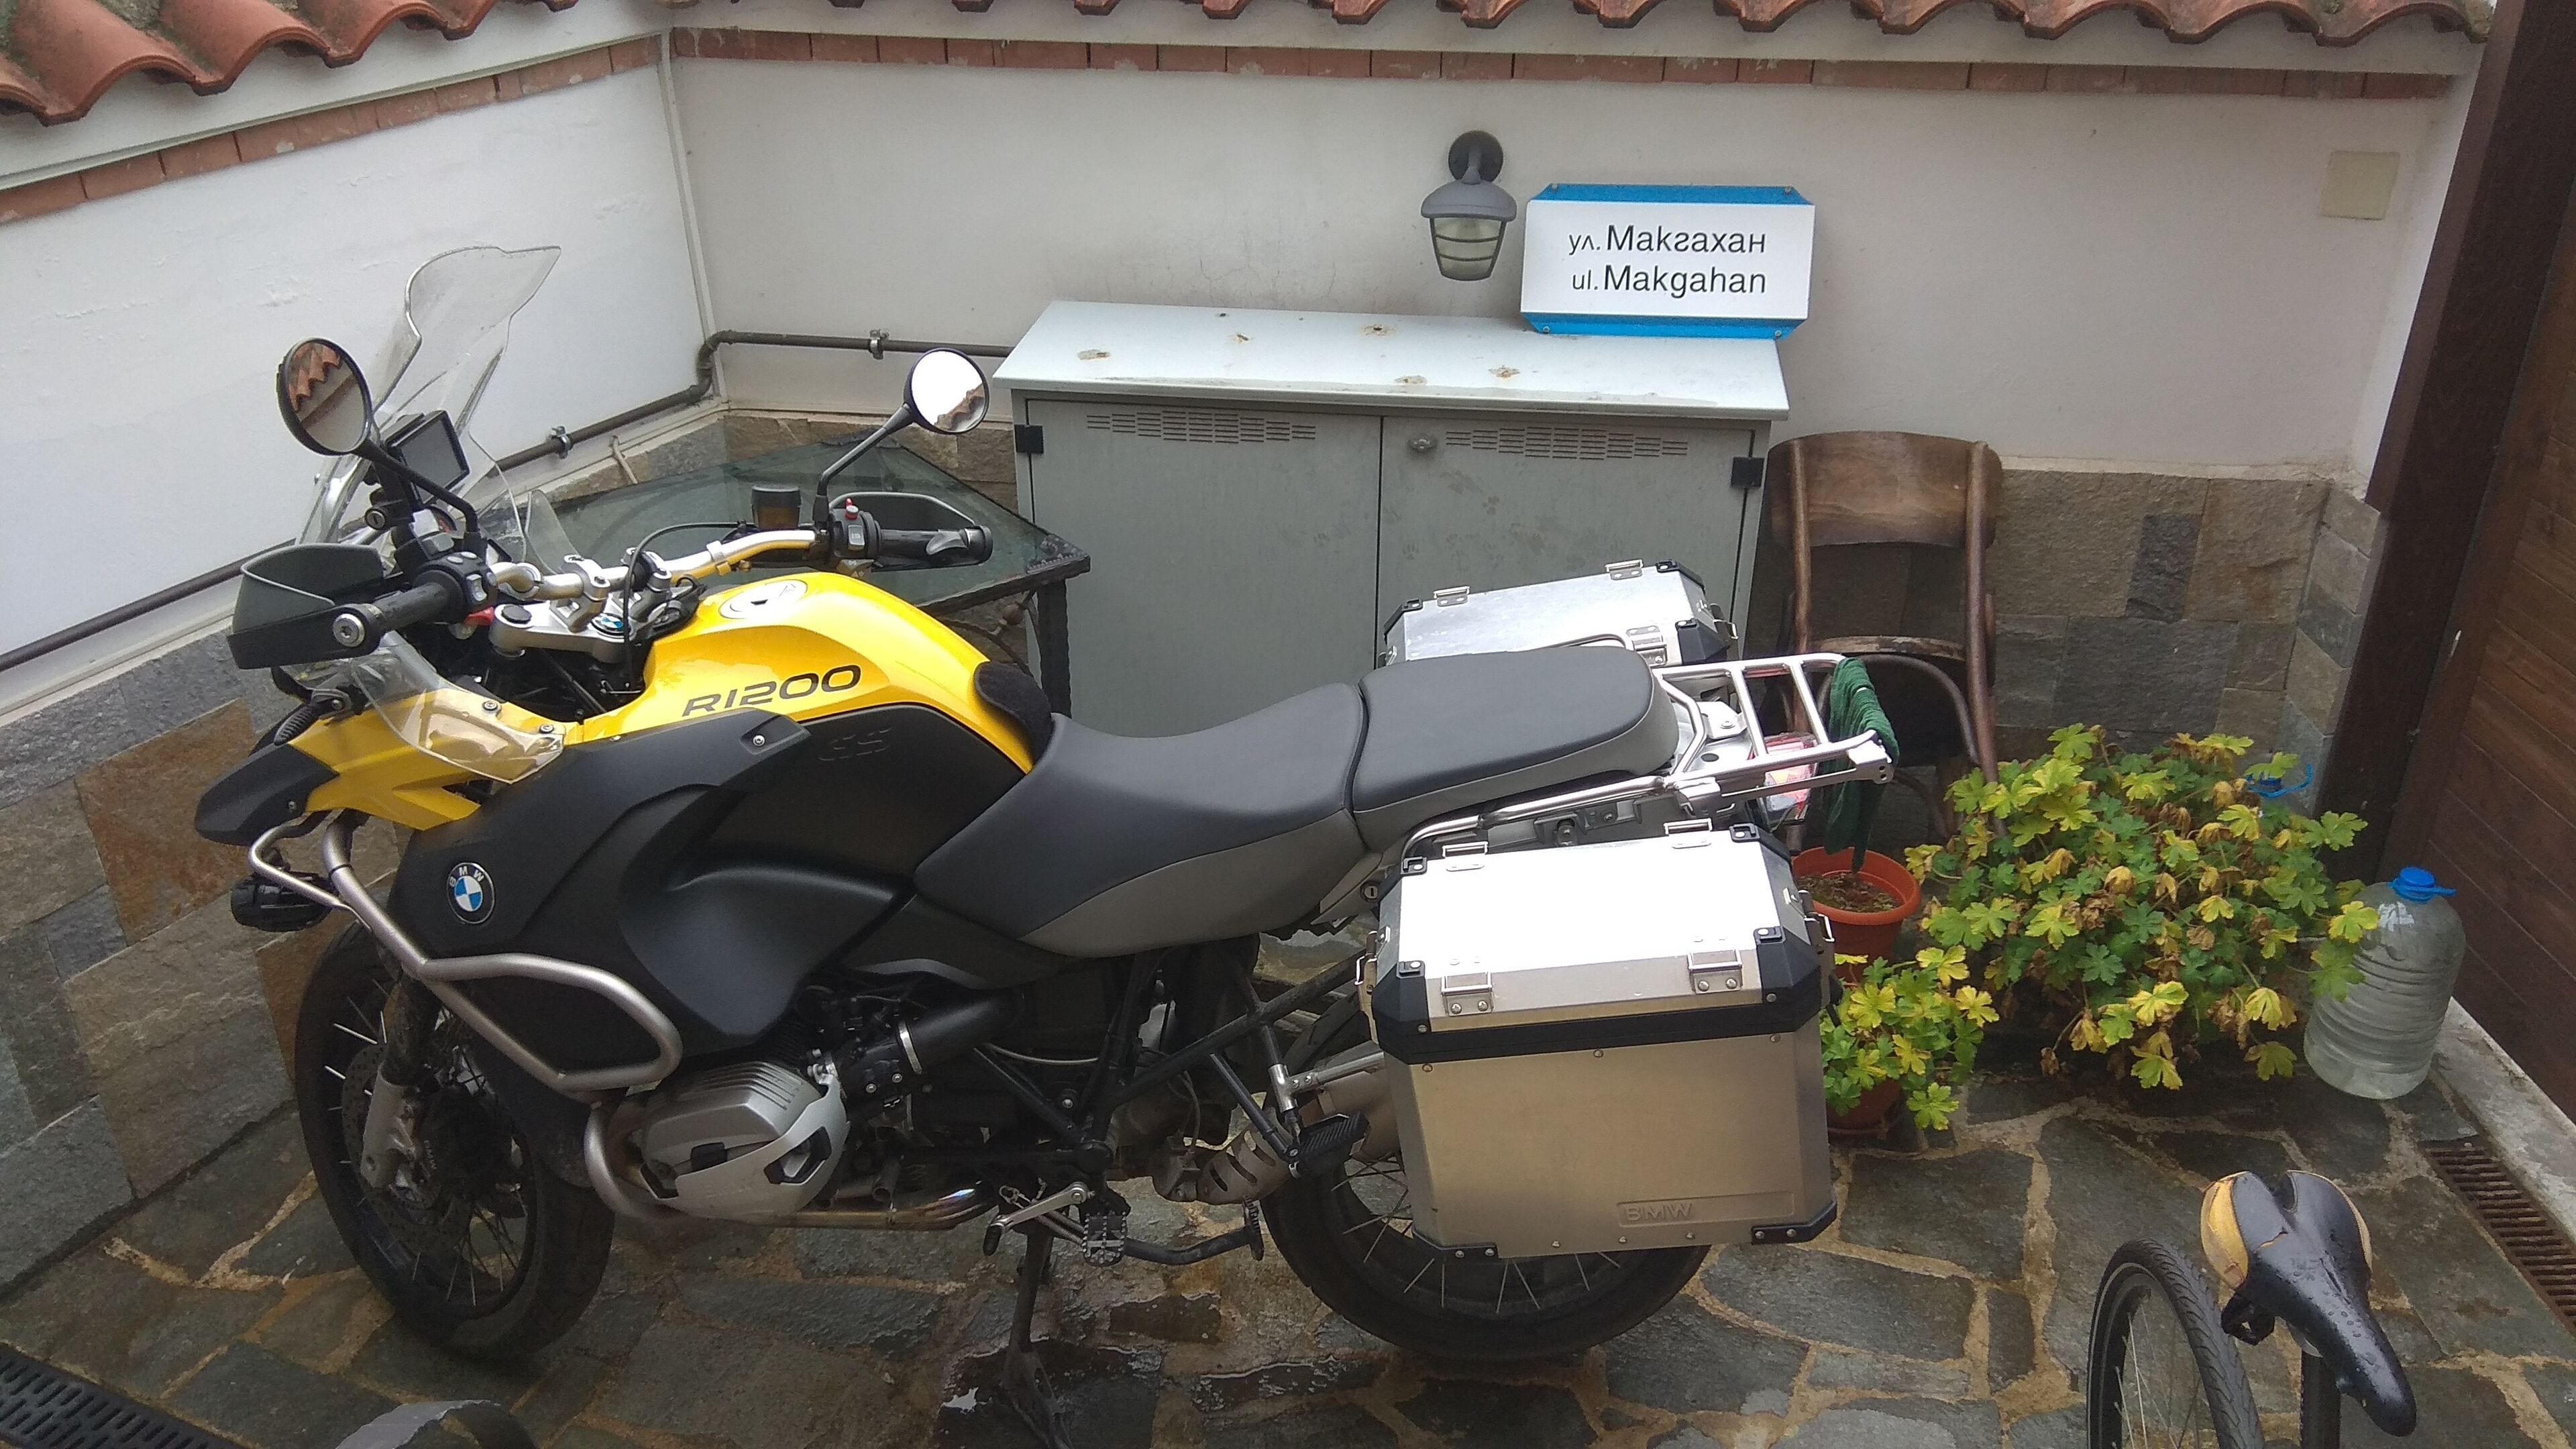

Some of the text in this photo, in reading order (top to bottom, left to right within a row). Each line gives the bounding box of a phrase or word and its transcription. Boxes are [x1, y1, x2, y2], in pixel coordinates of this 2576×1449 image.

[1568, 224, 1766, 256] ул. Макгахан
[1572, 264, 1766, 299] ul. Makgahan
[681, 664, 862, 718] R1200
[818, 727, 894, 762] GS
[448, 865, 484, 888] BMW
[1624, 1203, 1693, 1222] BMW
